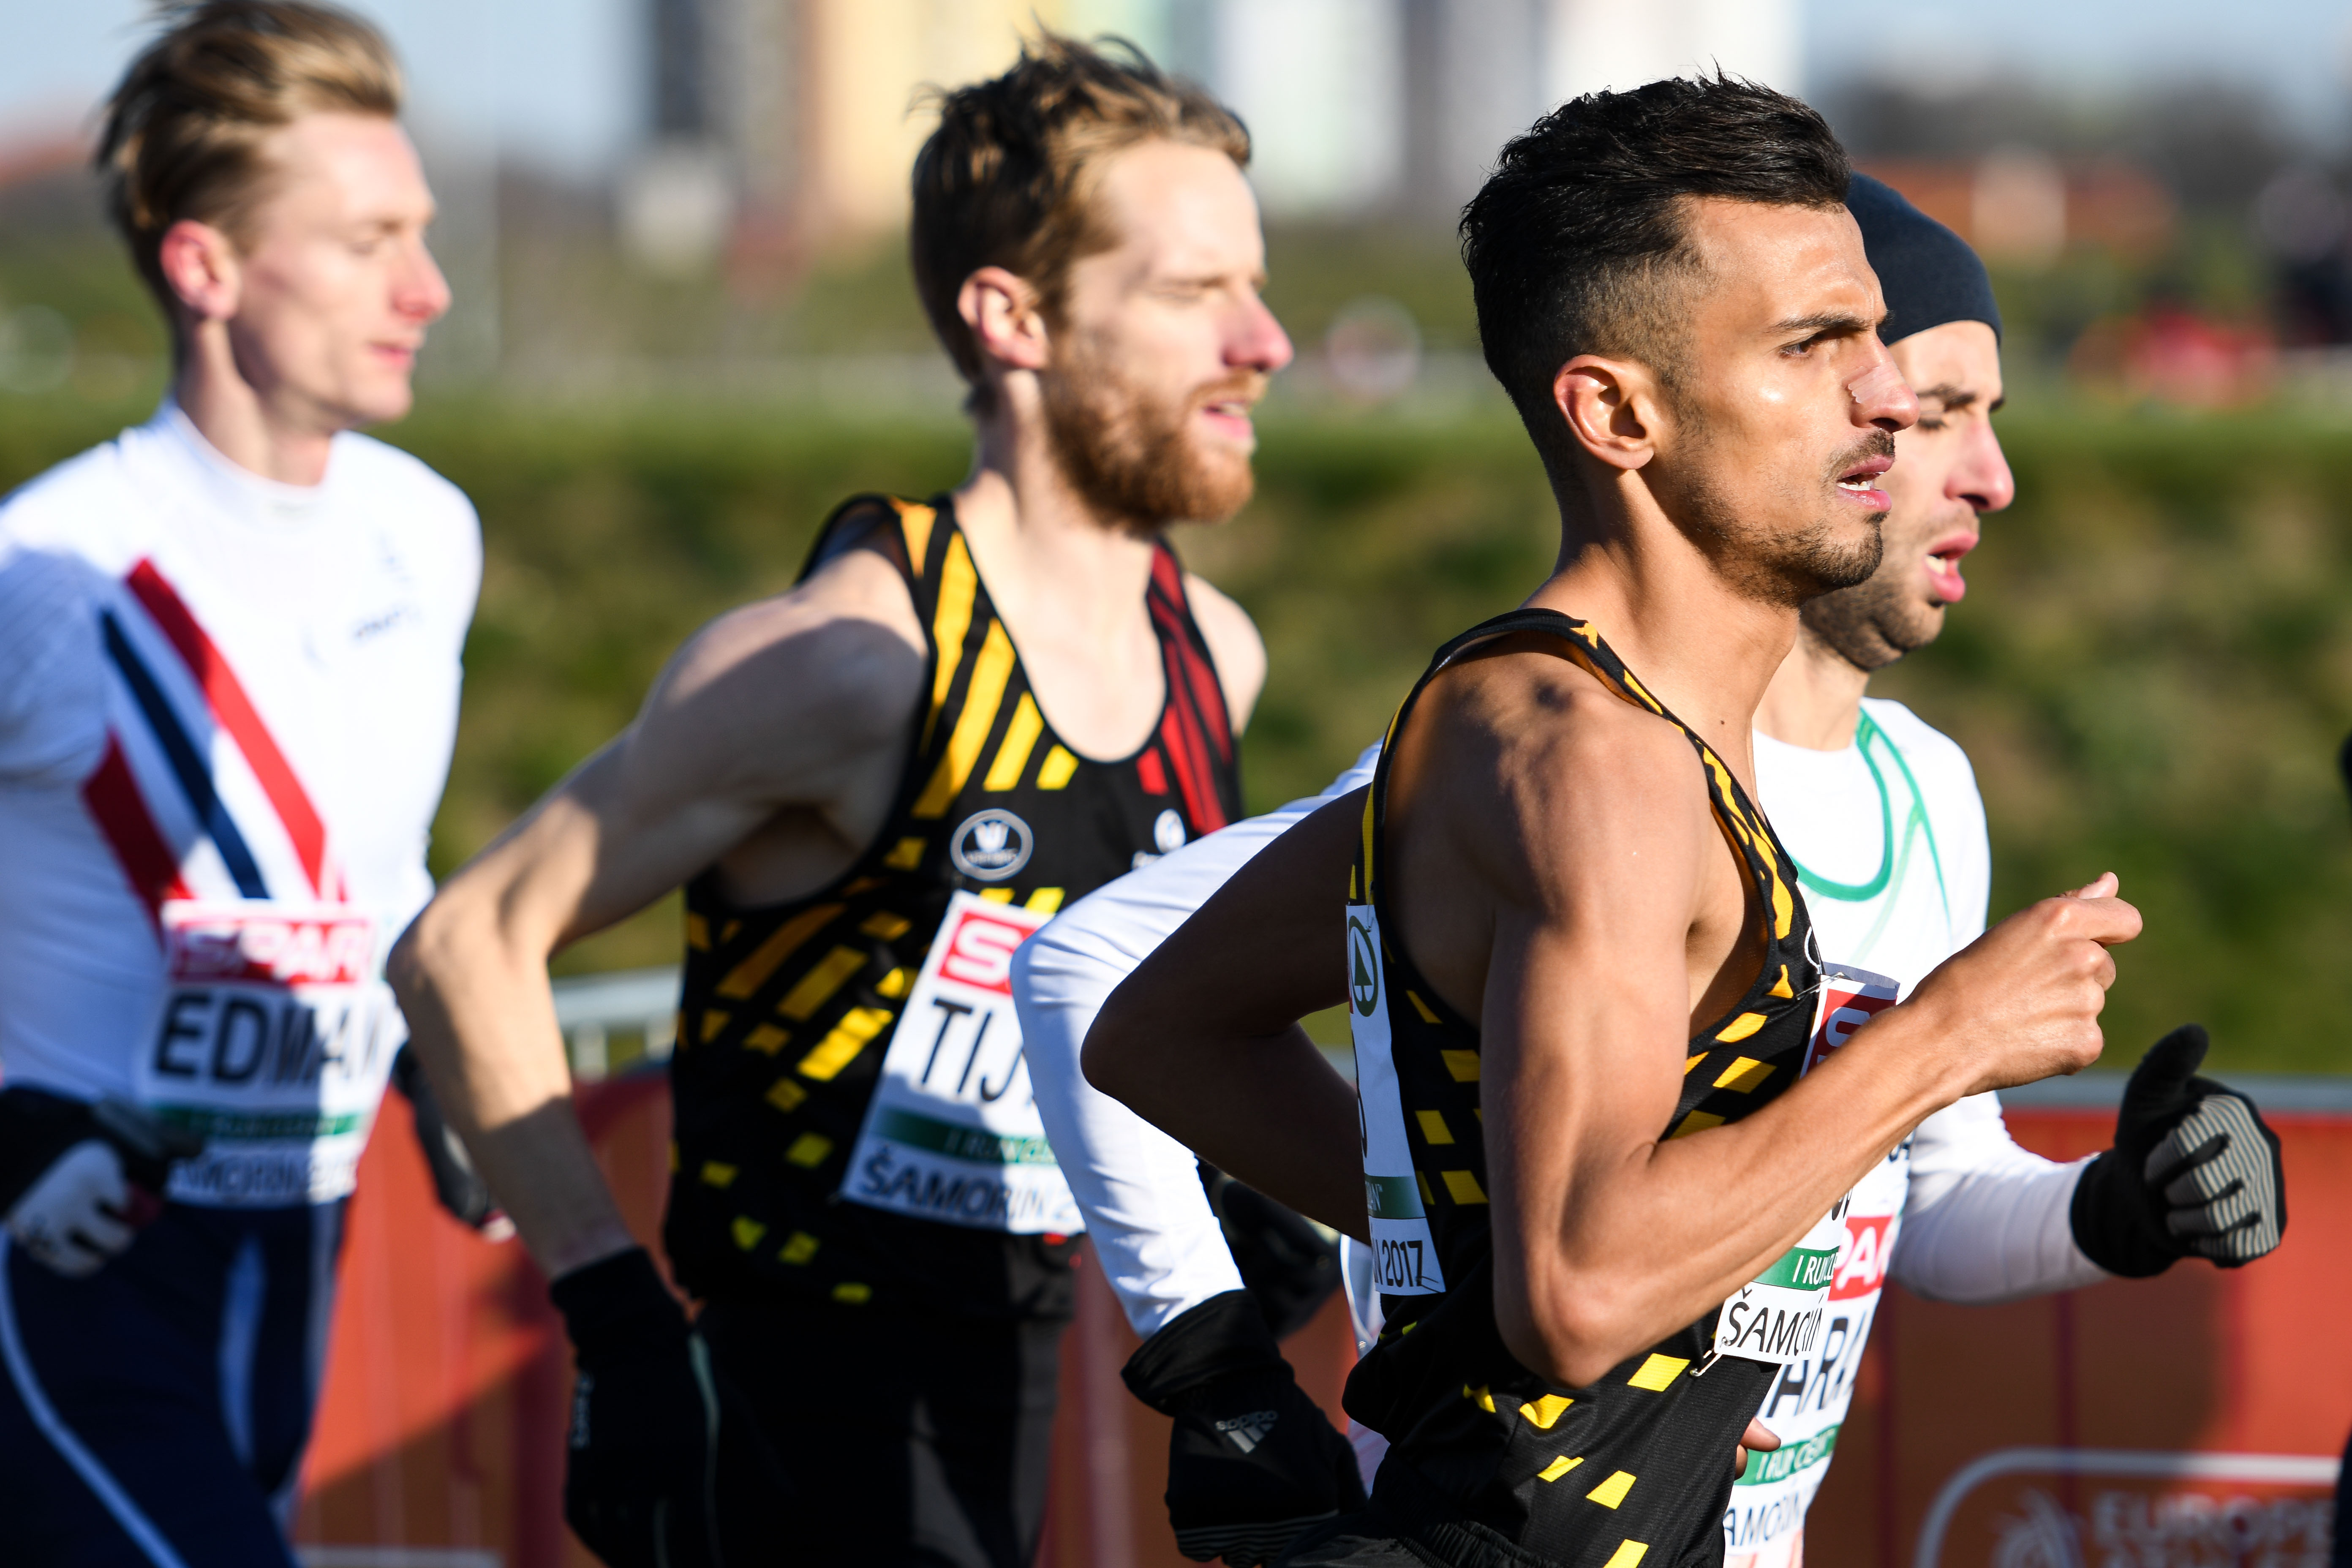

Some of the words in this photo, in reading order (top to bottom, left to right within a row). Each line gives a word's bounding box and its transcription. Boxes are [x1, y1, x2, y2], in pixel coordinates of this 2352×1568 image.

[922, 998, 1030, 1103] TIJ
[1382, 1239, 1423, 1288] 2017
[1792, 1255, 1804, 1282] I
